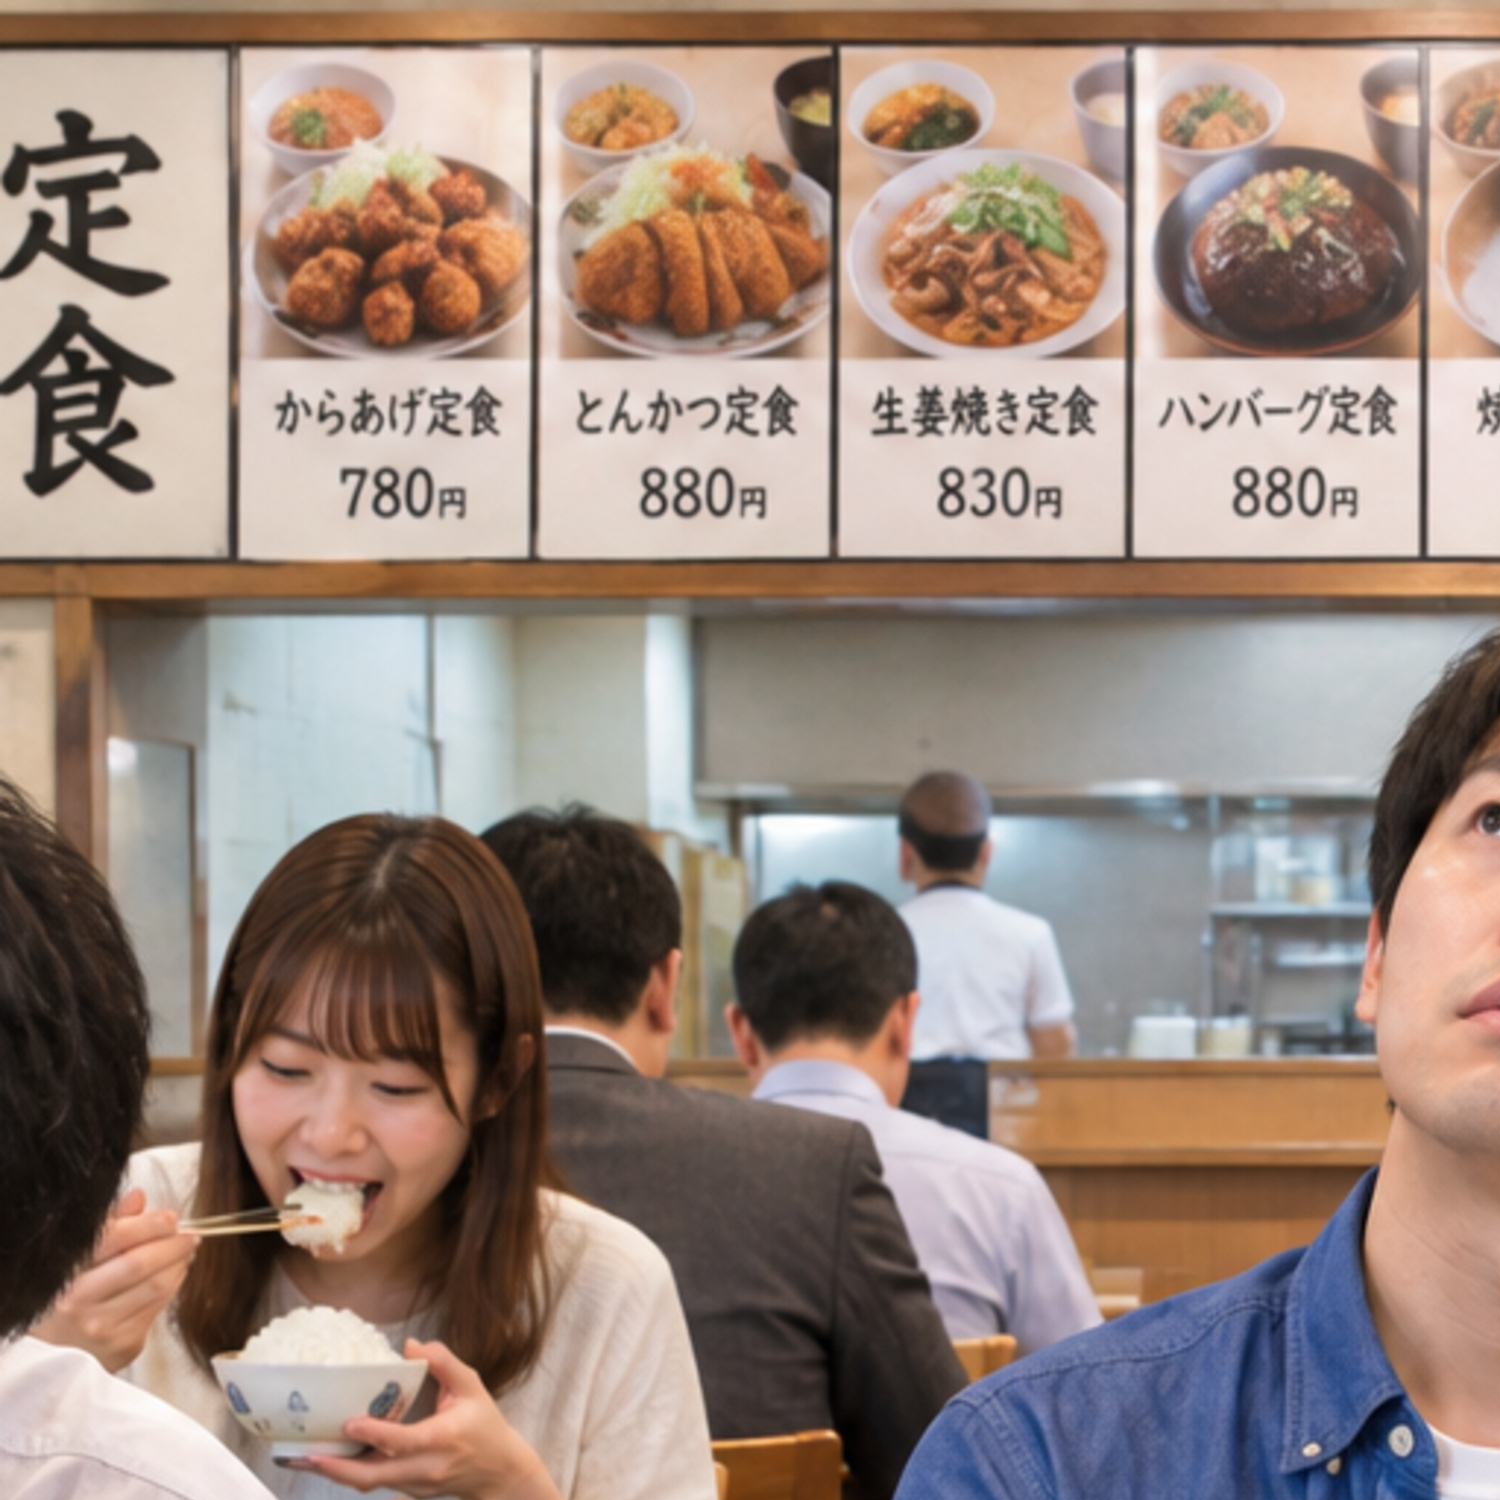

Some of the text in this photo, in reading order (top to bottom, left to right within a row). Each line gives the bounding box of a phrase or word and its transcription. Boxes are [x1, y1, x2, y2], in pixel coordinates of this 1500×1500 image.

[0, 110, 174, 497] 定食
[274, 386, 503, 437] からあげ定食
[576, 385, 800, 437] とんかつ定食
[870, 385, 1099, 438] 生姜焼き定食
[1158, 385, 1398, 436] ハンバーグ定食
[339, 466, 467, 519] 780円
[639, 467, 767, 519] 880円
[936, 466, 1063, 519] 830円
[1231, 466, 1359, 518] 880円
